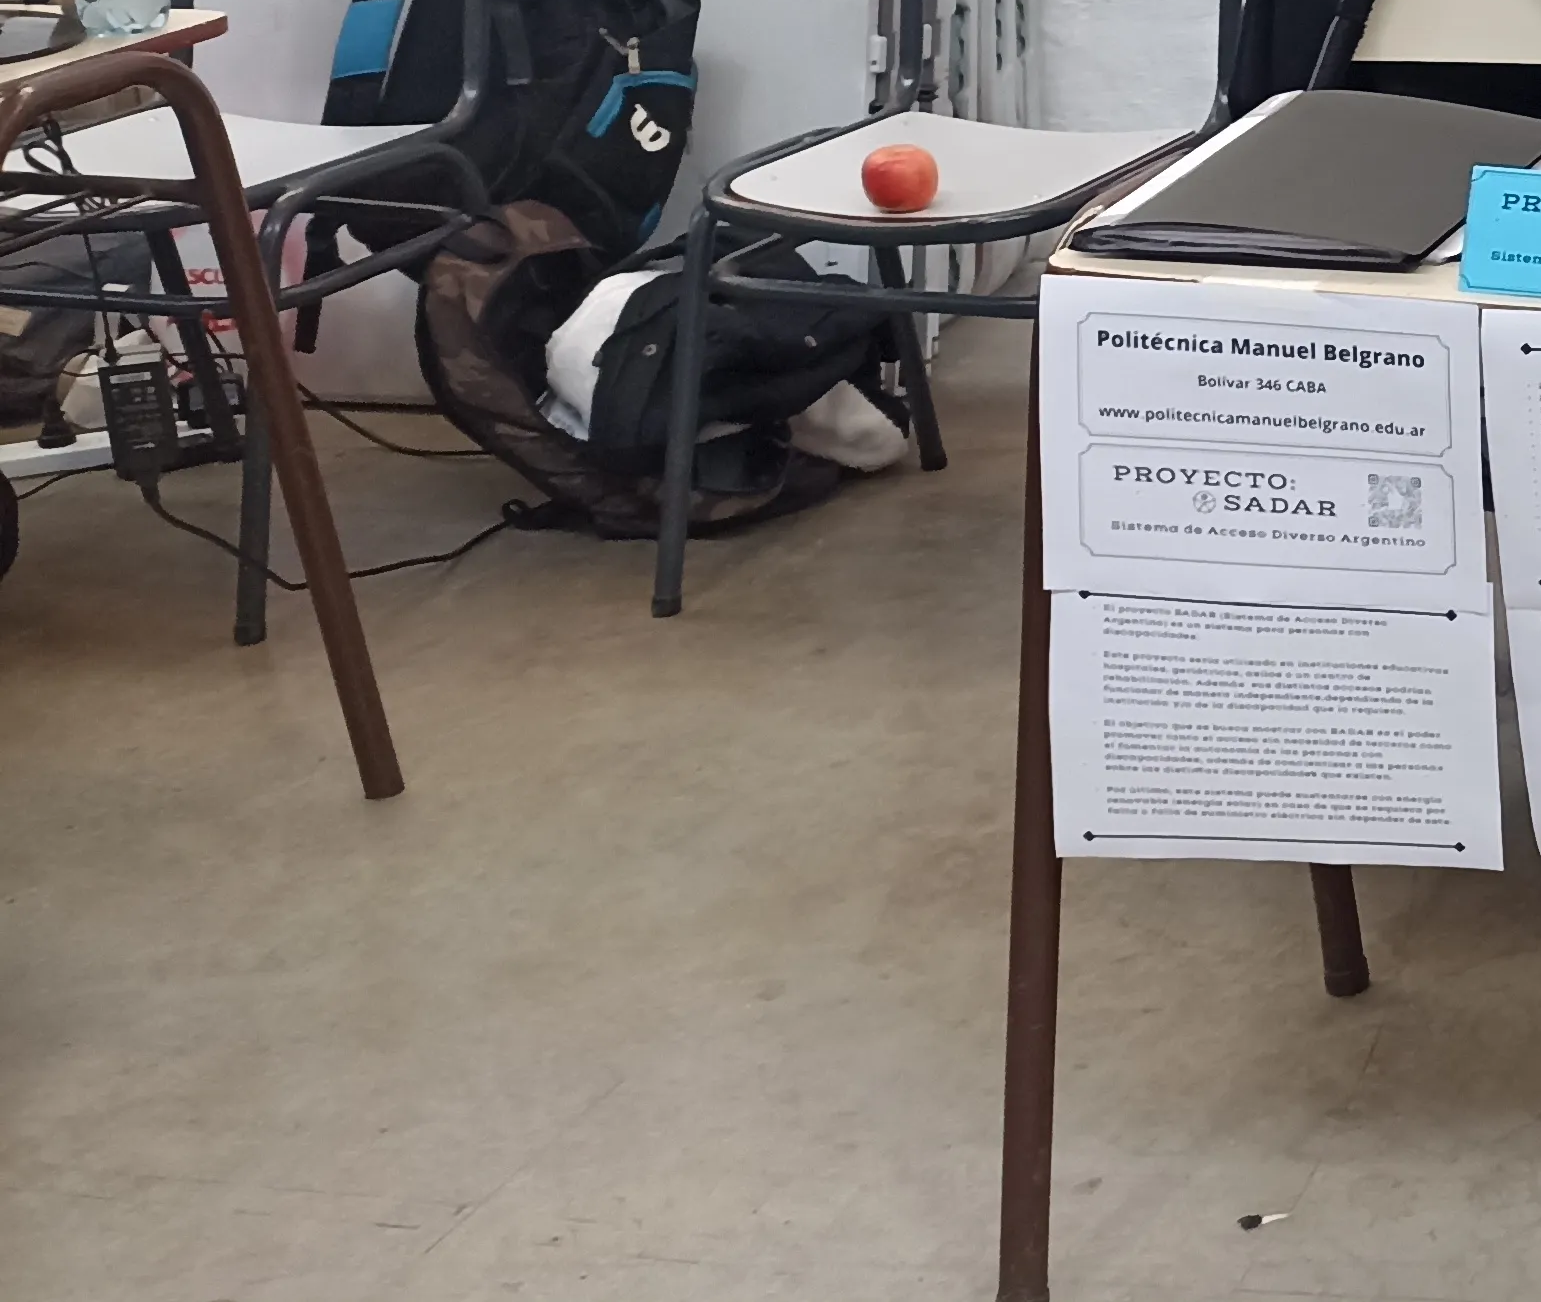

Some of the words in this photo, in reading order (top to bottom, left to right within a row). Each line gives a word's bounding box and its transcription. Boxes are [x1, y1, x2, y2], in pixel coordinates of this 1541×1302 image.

[1097, 329, 1223, 354] Politécnica
[1231, 337, 1316, 360] Manuel
[1323, 343, 1425, 369] Belgrano
[1197, 374, 1250, 389] Bolívar
[1256, 377, 1282, 391] 346
[1285, 379, 1326, 394] CABA
[1098, 407, 1426, 437] www.politecnicamanuelbelgrano.edu.ar
[1113, 464, 1295, 490] PROYECTO:
[1223, 494, 1336, 517] SADAR
[1110, 520, 1179, 533] Sistema
[1183, 524, 1203, 535] de
[1207, 526, 1267, 538] Acceso
[1271, 529, 1336, 543] Diverso
[1340, 533, 1426, 547] Argentino
